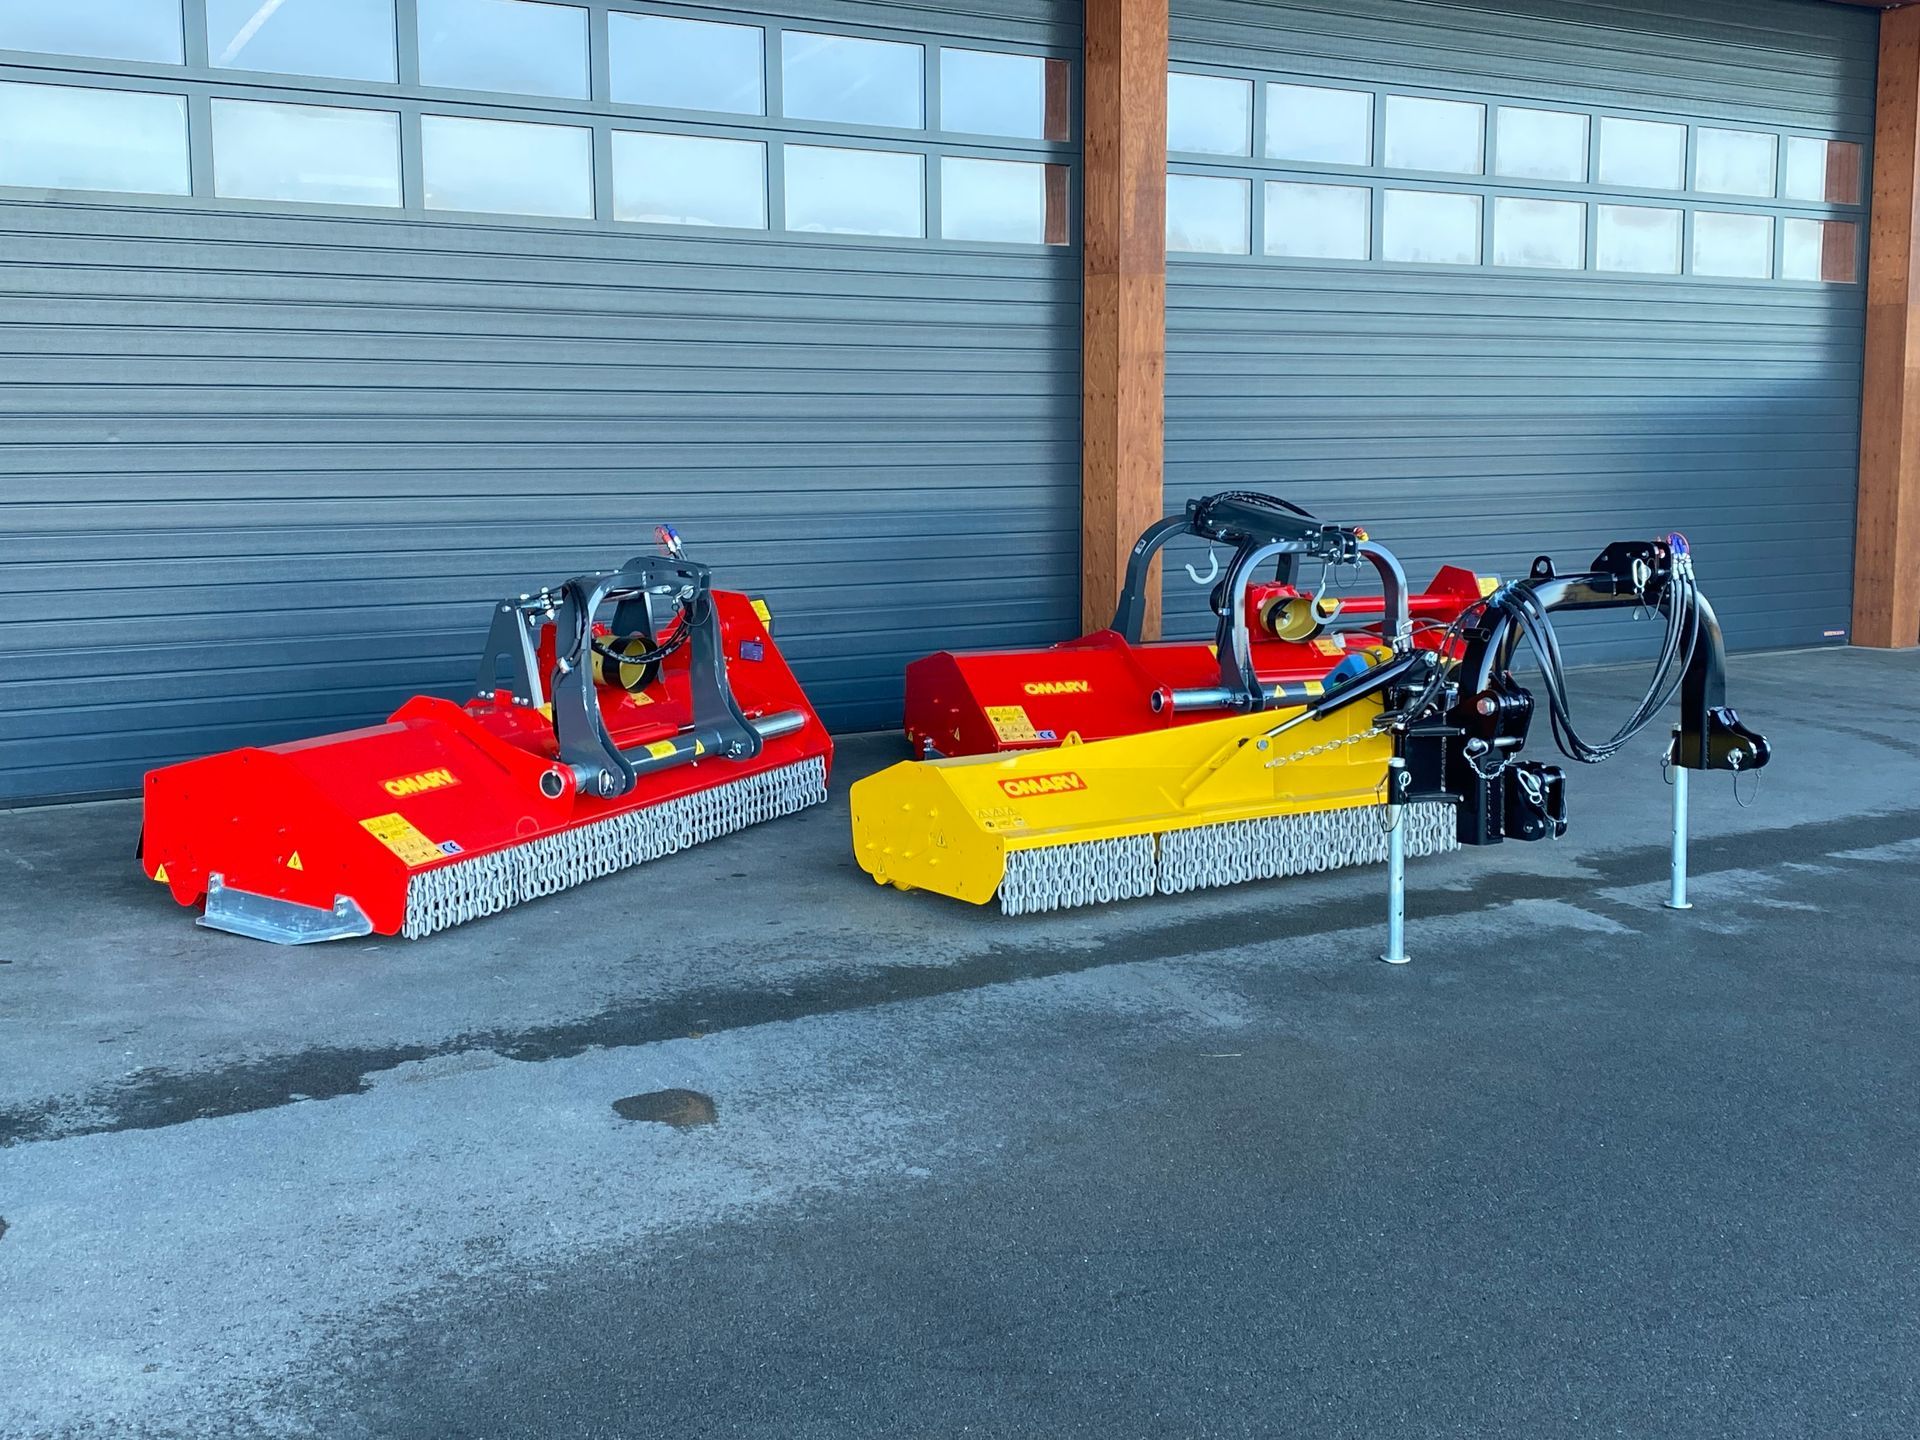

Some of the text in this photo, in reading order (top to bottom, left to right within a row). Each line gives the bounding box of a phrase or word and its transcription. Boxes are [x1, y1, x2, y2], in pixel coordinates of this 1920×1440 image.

[1024, 681, 1088, 694] OMARV
[384, 769, 454, 796] OMARV
[1003, 773, 1080, 796] OMARV
